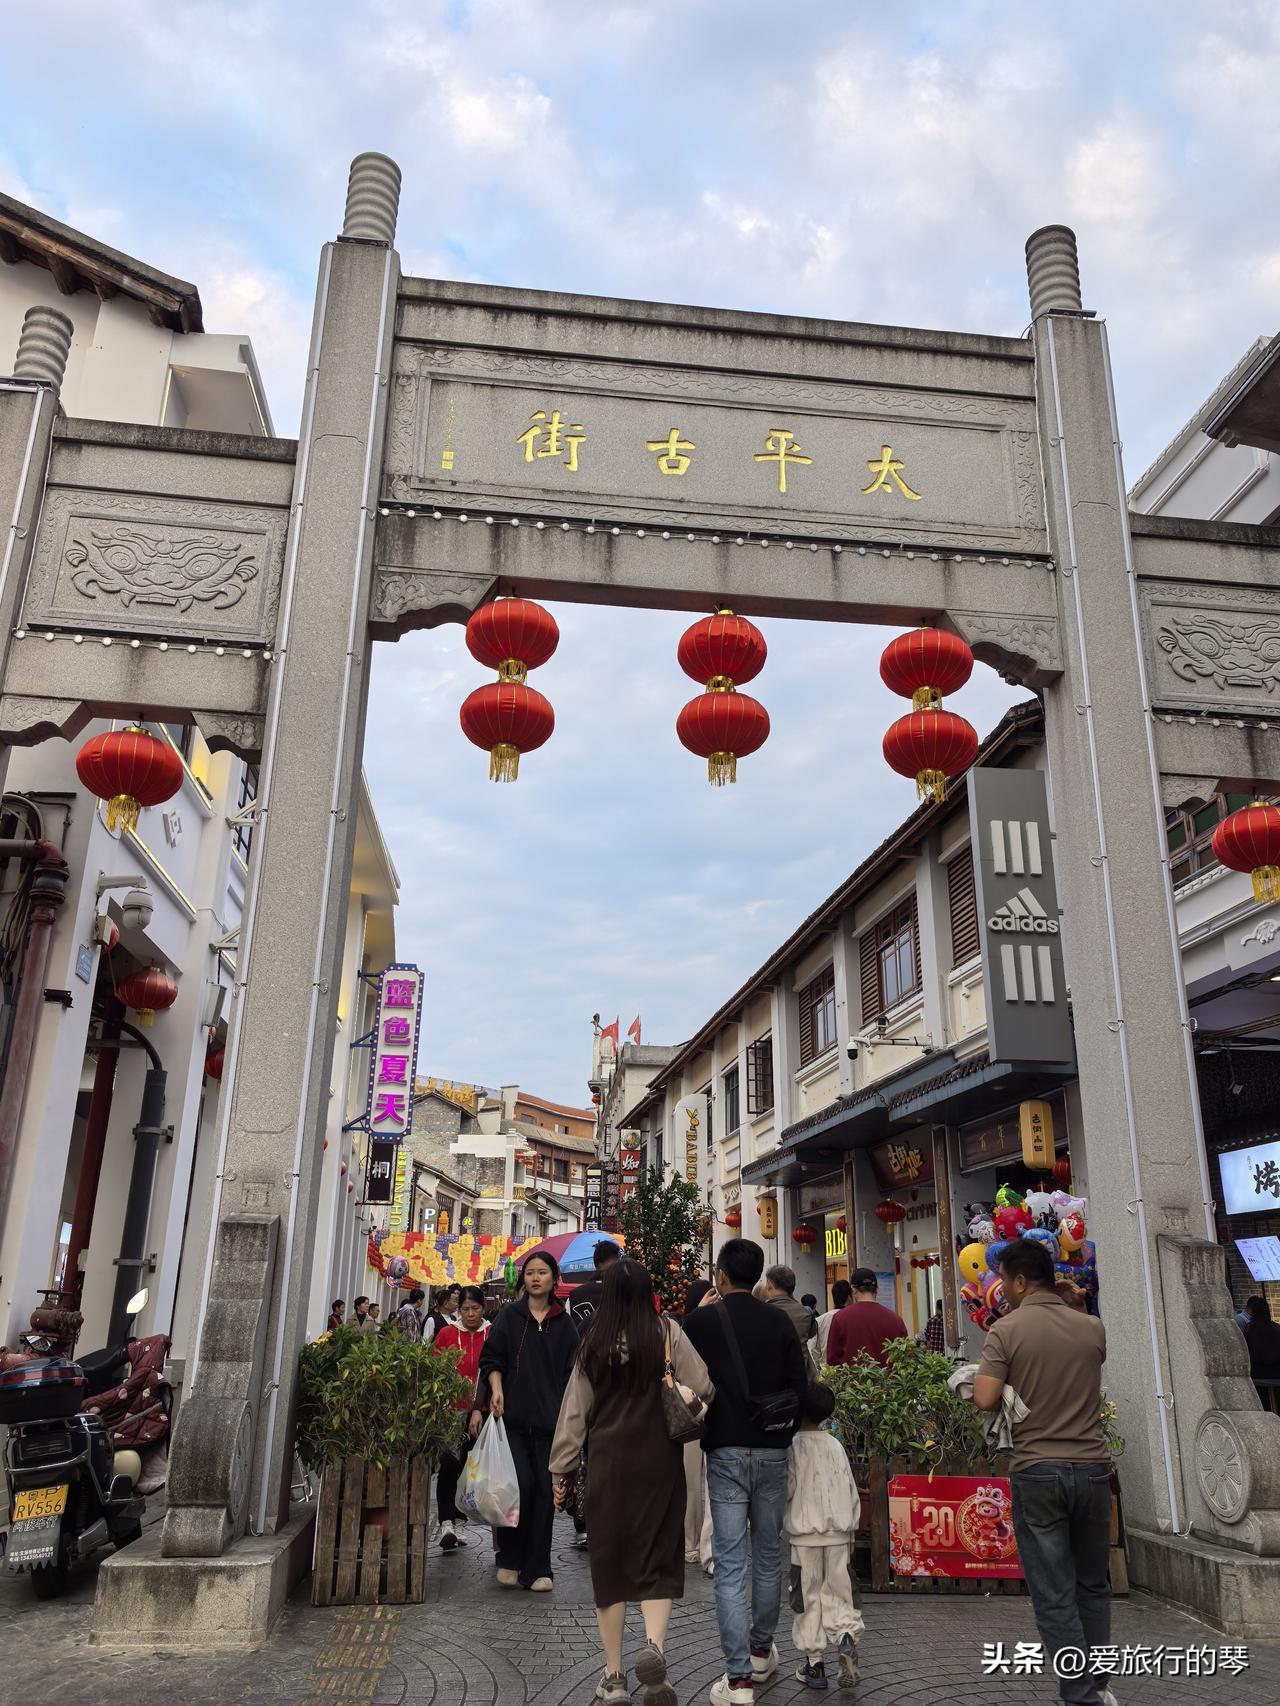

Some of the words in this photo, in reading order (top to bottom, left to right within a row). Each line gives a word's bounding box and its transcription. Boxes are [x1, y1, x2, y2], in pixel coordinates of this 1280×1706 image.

[987, 913, 1059, 934] adidas
[373, 978, 417, 1125] 蓝色夏天
[1031, 1113, 1044, 1153] 古街小吃
[1253, 1159, 1280, 1199] 烤
[825, 1228, 848, 1257] BIB
[16, 1498, 63, 1519] RV556
